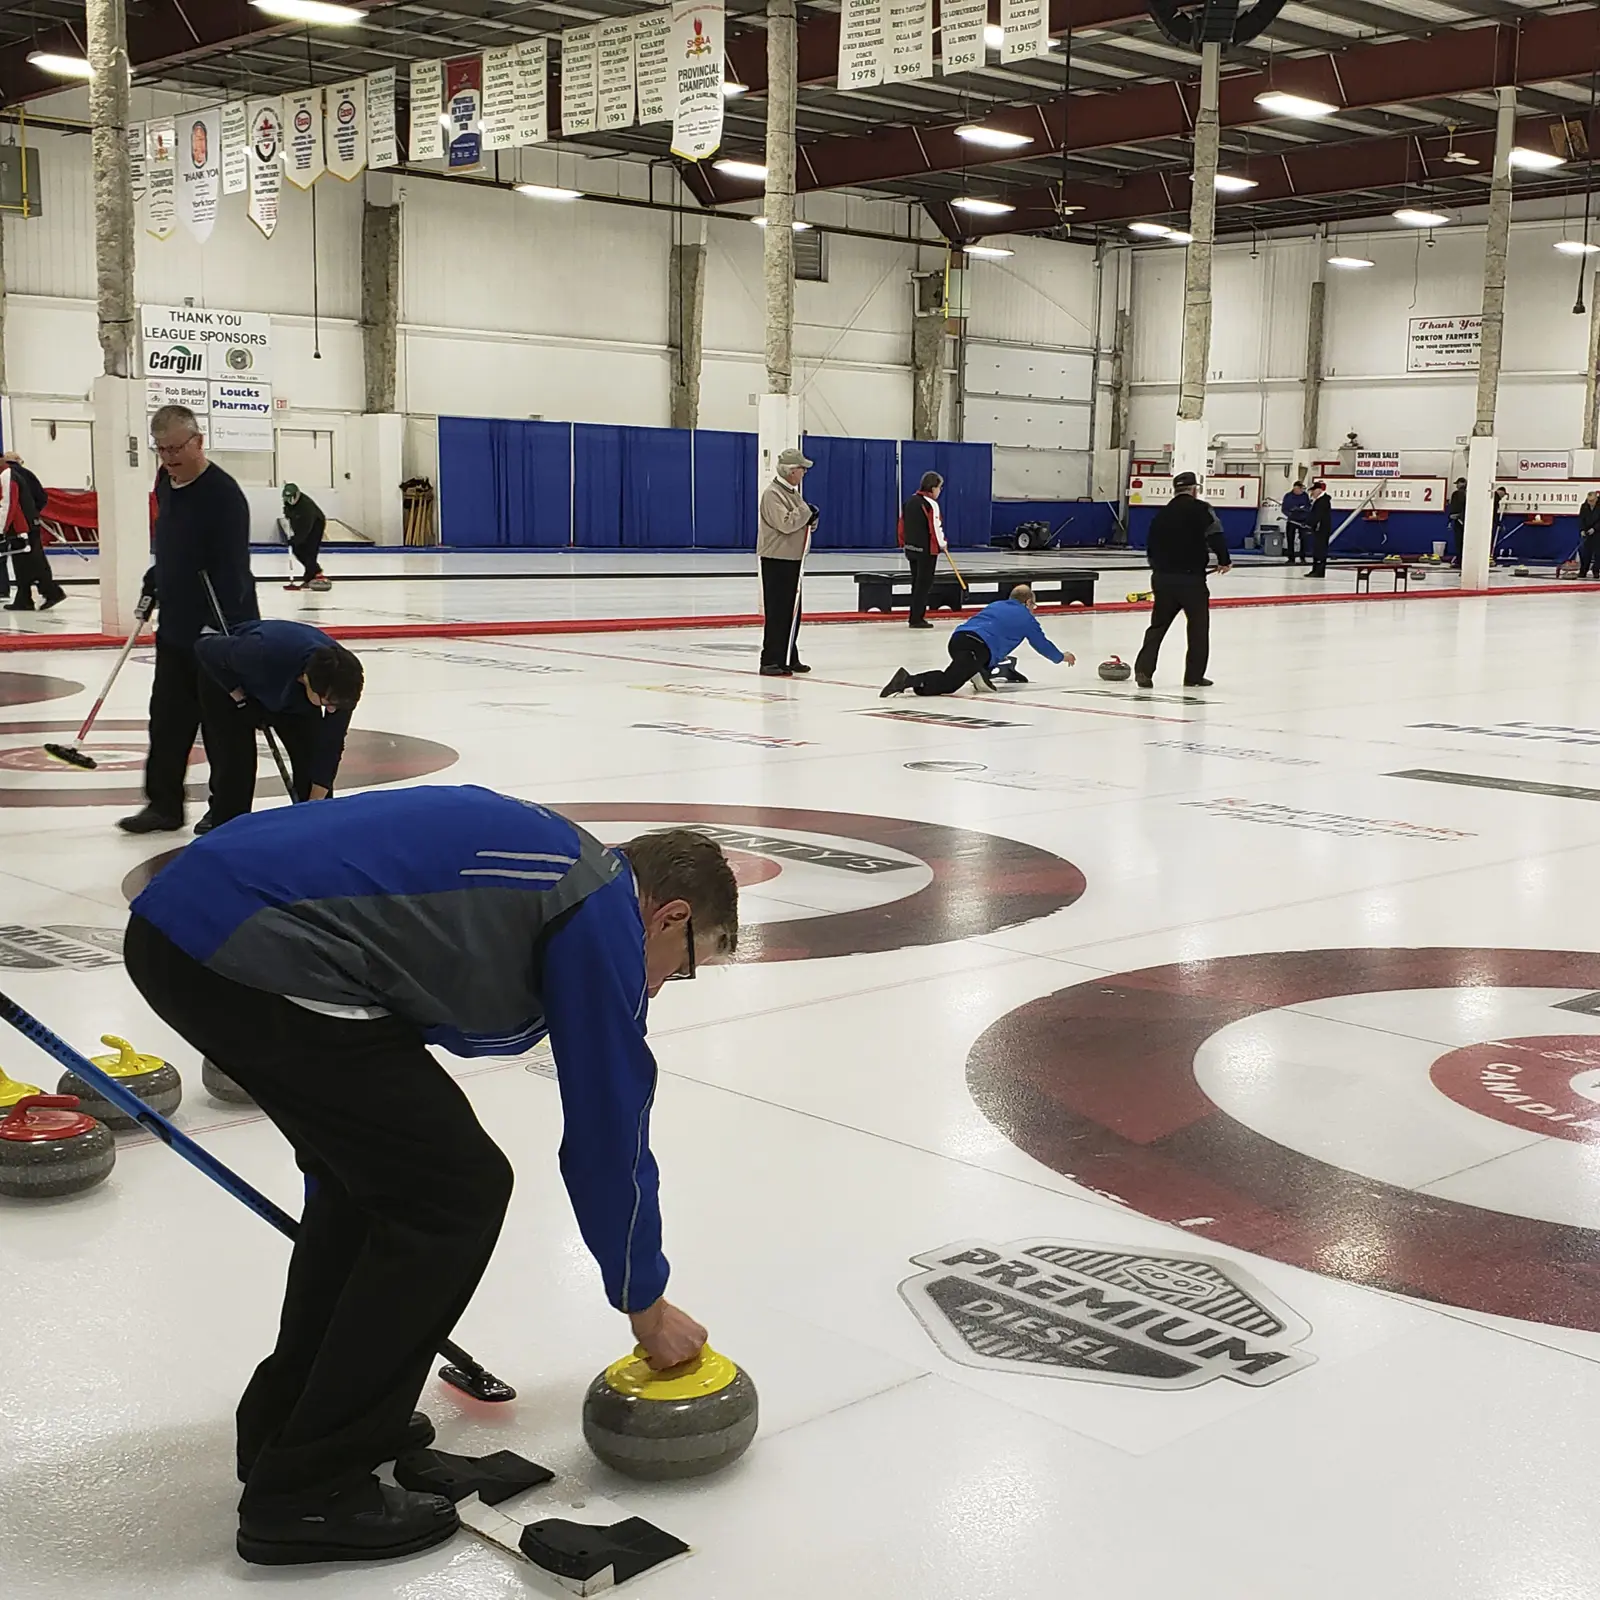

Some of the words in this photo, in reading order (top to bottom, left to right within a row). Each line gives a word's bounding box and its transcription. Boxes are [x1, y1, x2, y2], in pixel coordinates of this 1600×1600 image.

[639, 16, 665, 28] SASK
[603, 24, 628, 36] SASK
[568, 32, 590, 42] SASK
[520, 45, 542, 56] SASK
[678, 63, 720, 81] PROVINCIAL
[894, 62, 921, 74] 1969
[851, 69, 876, 80] 1978
[678, 75, 719, 93] CHAMPIONS
[642, 105, 663, 116] 1986
[169, 310, 214, 325] THANK
[216, 314, 242, 326] YOU
[1418, 320, 1454, 330] Thank
[1458, 320, 1482, 330] You
[144, 327, 196, 341] LEAGUE
[200, 330, 267, 346] SPONSORS
[1412, 334, 1443, 342] YORKTON
[1445, 332, 1479, 340] FARMER'S
[150, 351, 202, 374] Cargill
[165, 387, 179, 396] Rob
[220, 387, 260, 397] Loucks
[212, 400, 270, 414] Pharmacy
[1239, 485, 1245, 499] 1
[1424, 488, 1432, 502] 2
[1572, 493, 1577, 502] 12
[941, 1248, 1291, 1375] PREMIUM
[959, 1300, 1122, 1366] DIESEL
